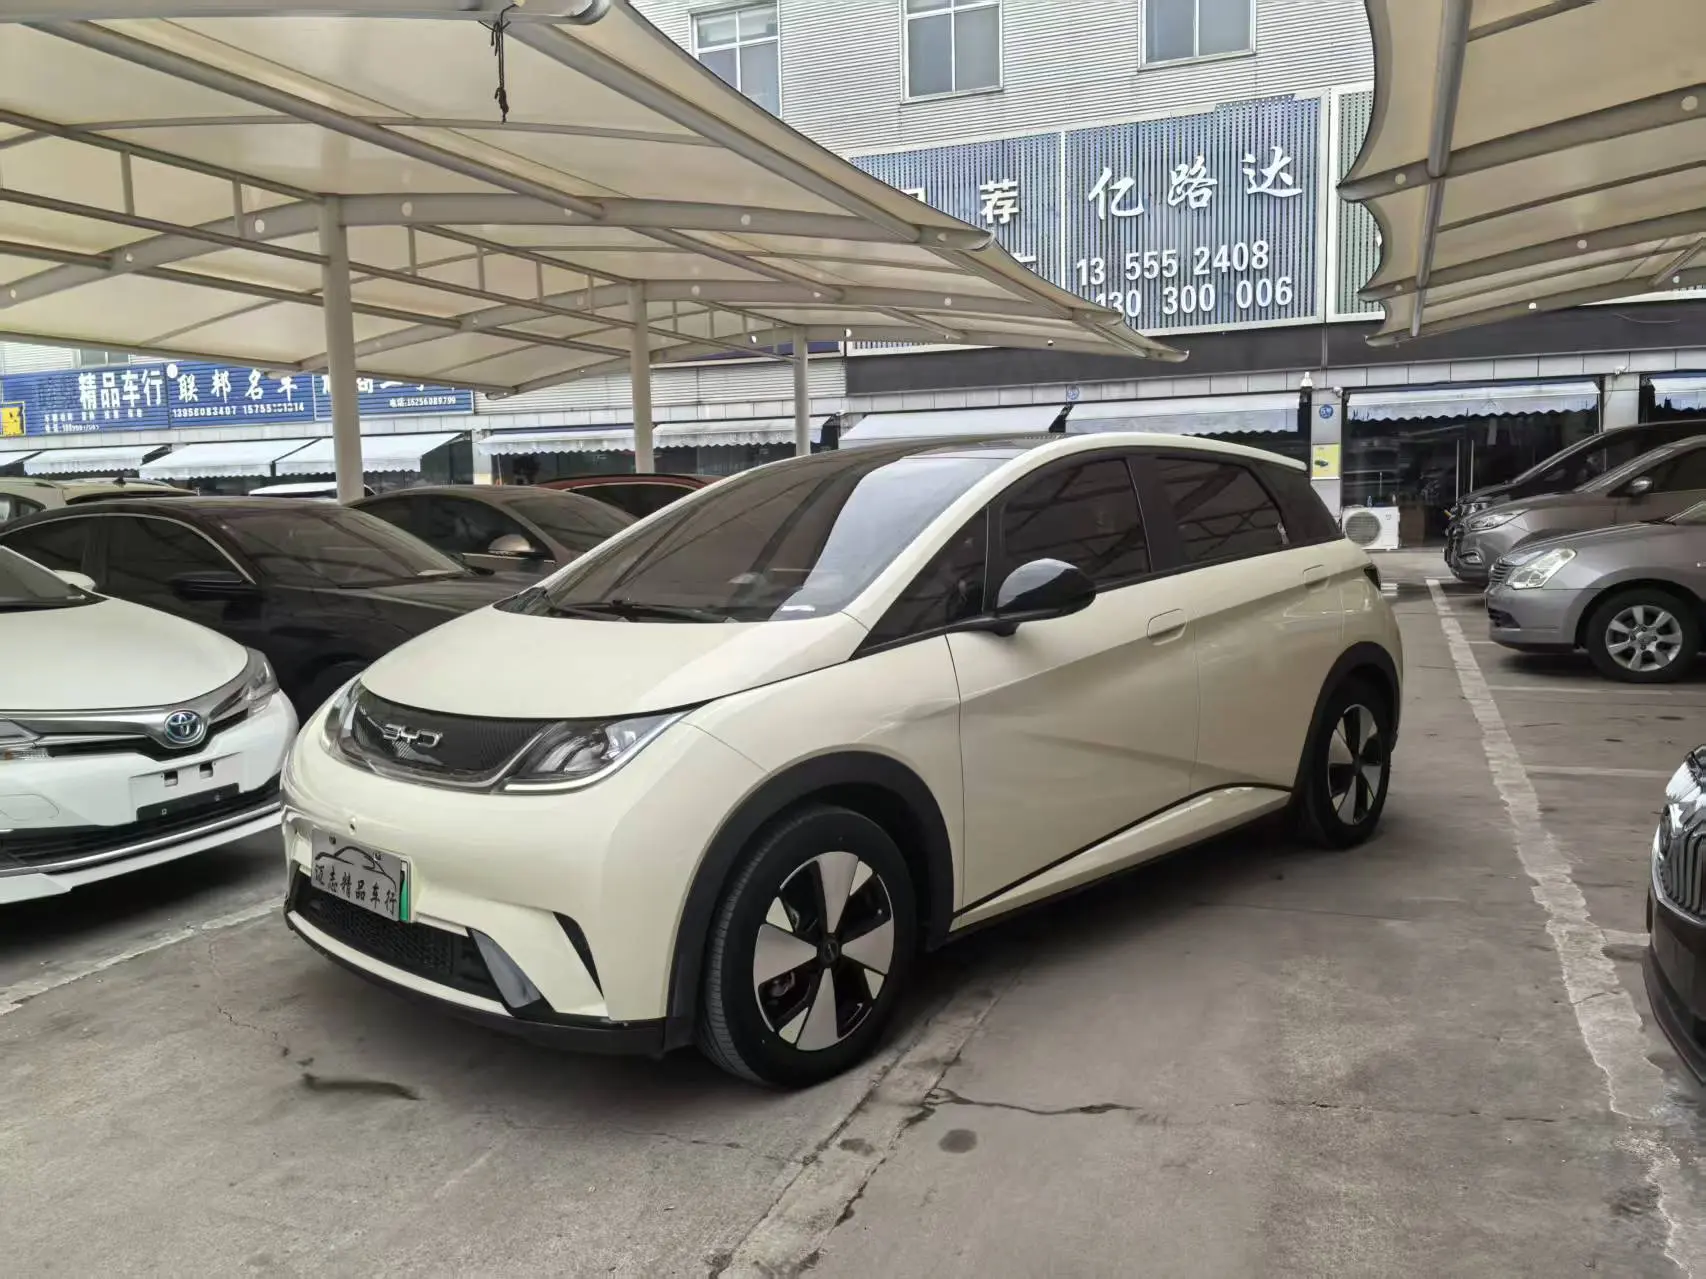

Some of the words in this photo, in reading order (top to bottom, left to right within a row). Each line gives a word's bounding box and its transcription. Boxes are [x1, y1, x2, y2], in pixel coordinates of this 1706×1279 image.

[1088, 146, 1302, 220] 亿路达
[1076, 257, 1106, 286] 13
[1125, 249, 1178, 281] 555
[1193, 240, 1270, 276] 2408
[1162, 283, 1216, 315] 300
[1235, 276, 1294, 309] 006
[78, 368, 163, 411] 精品车行
